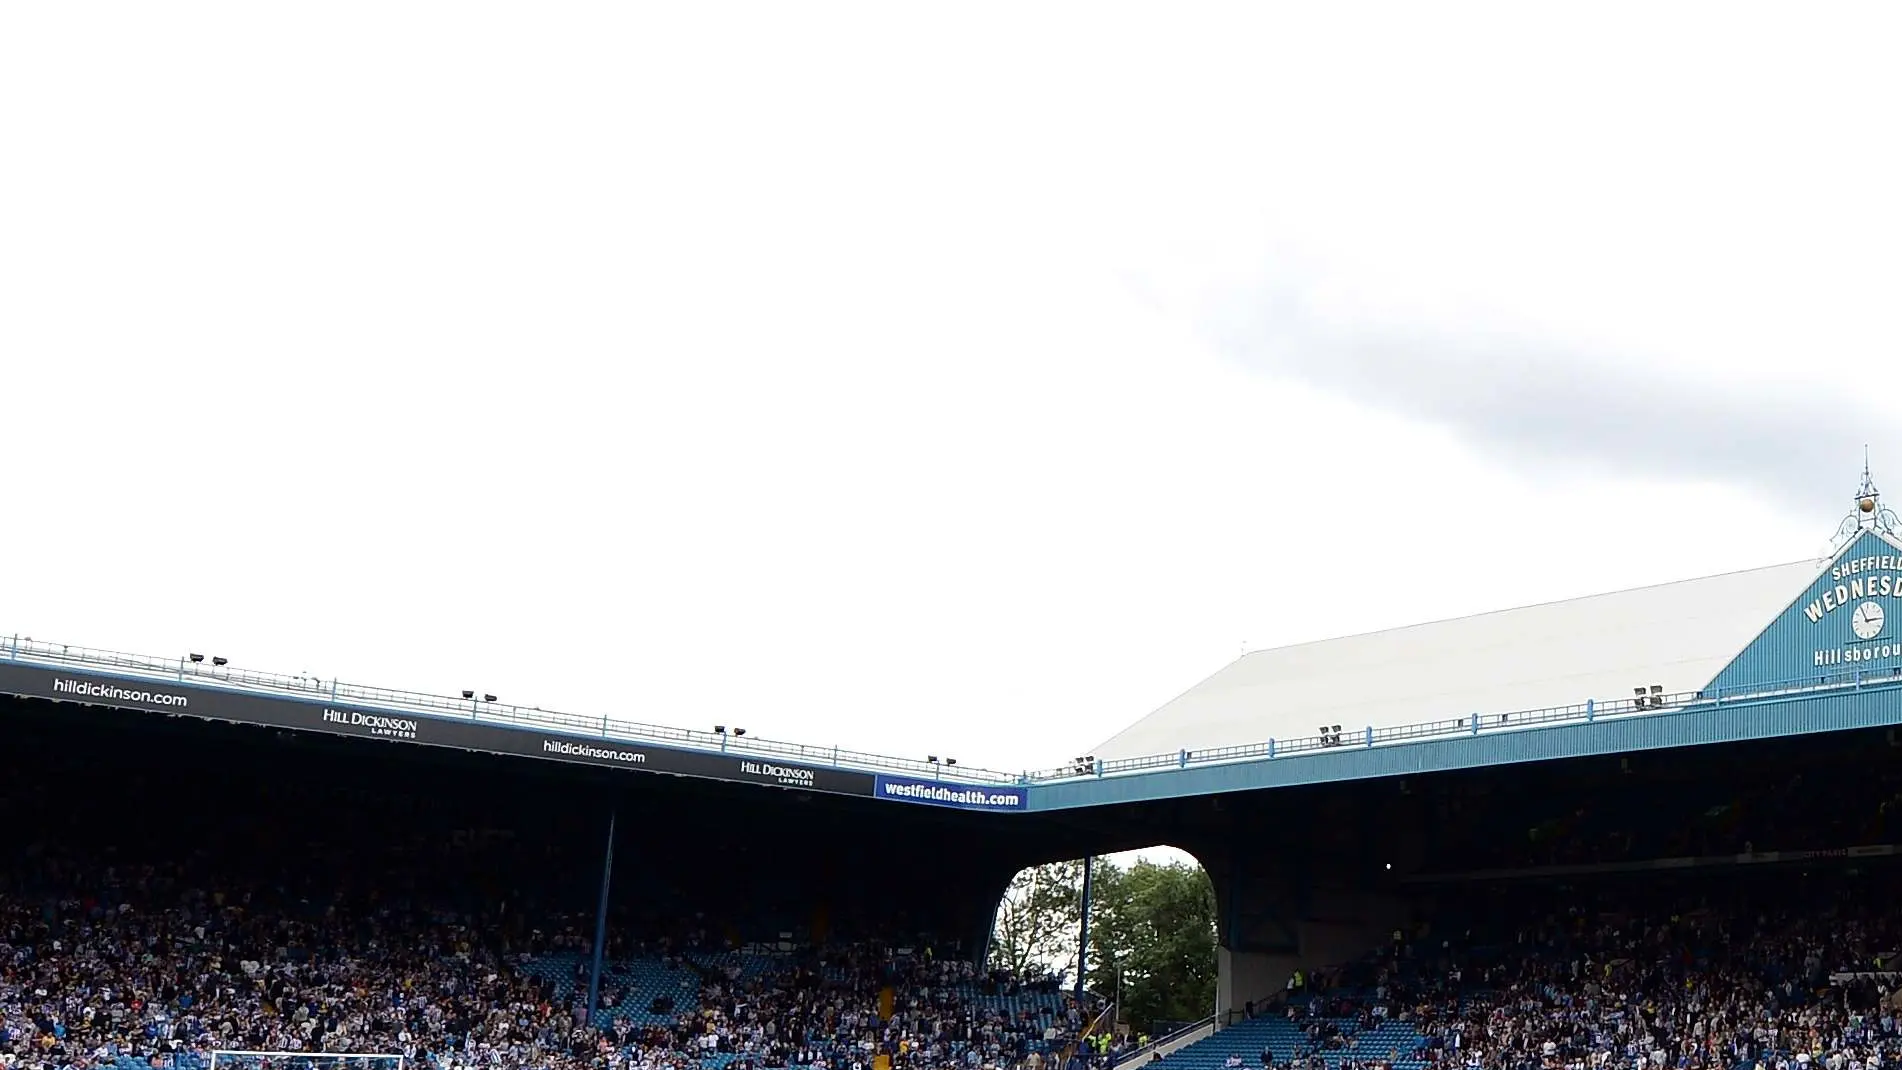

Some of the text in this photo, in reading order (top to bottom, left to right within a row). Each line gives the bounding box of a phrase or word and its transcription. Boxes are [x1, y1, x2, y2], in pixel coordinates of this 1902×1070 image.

[52, 677, 188, 708] hilldickinson.com
[371, 727, 417, 739] LAWYERS
[543, 739, 646, 764] hilldickinson.com
[884, 781, 1020, 807] westfieldhealth.com
